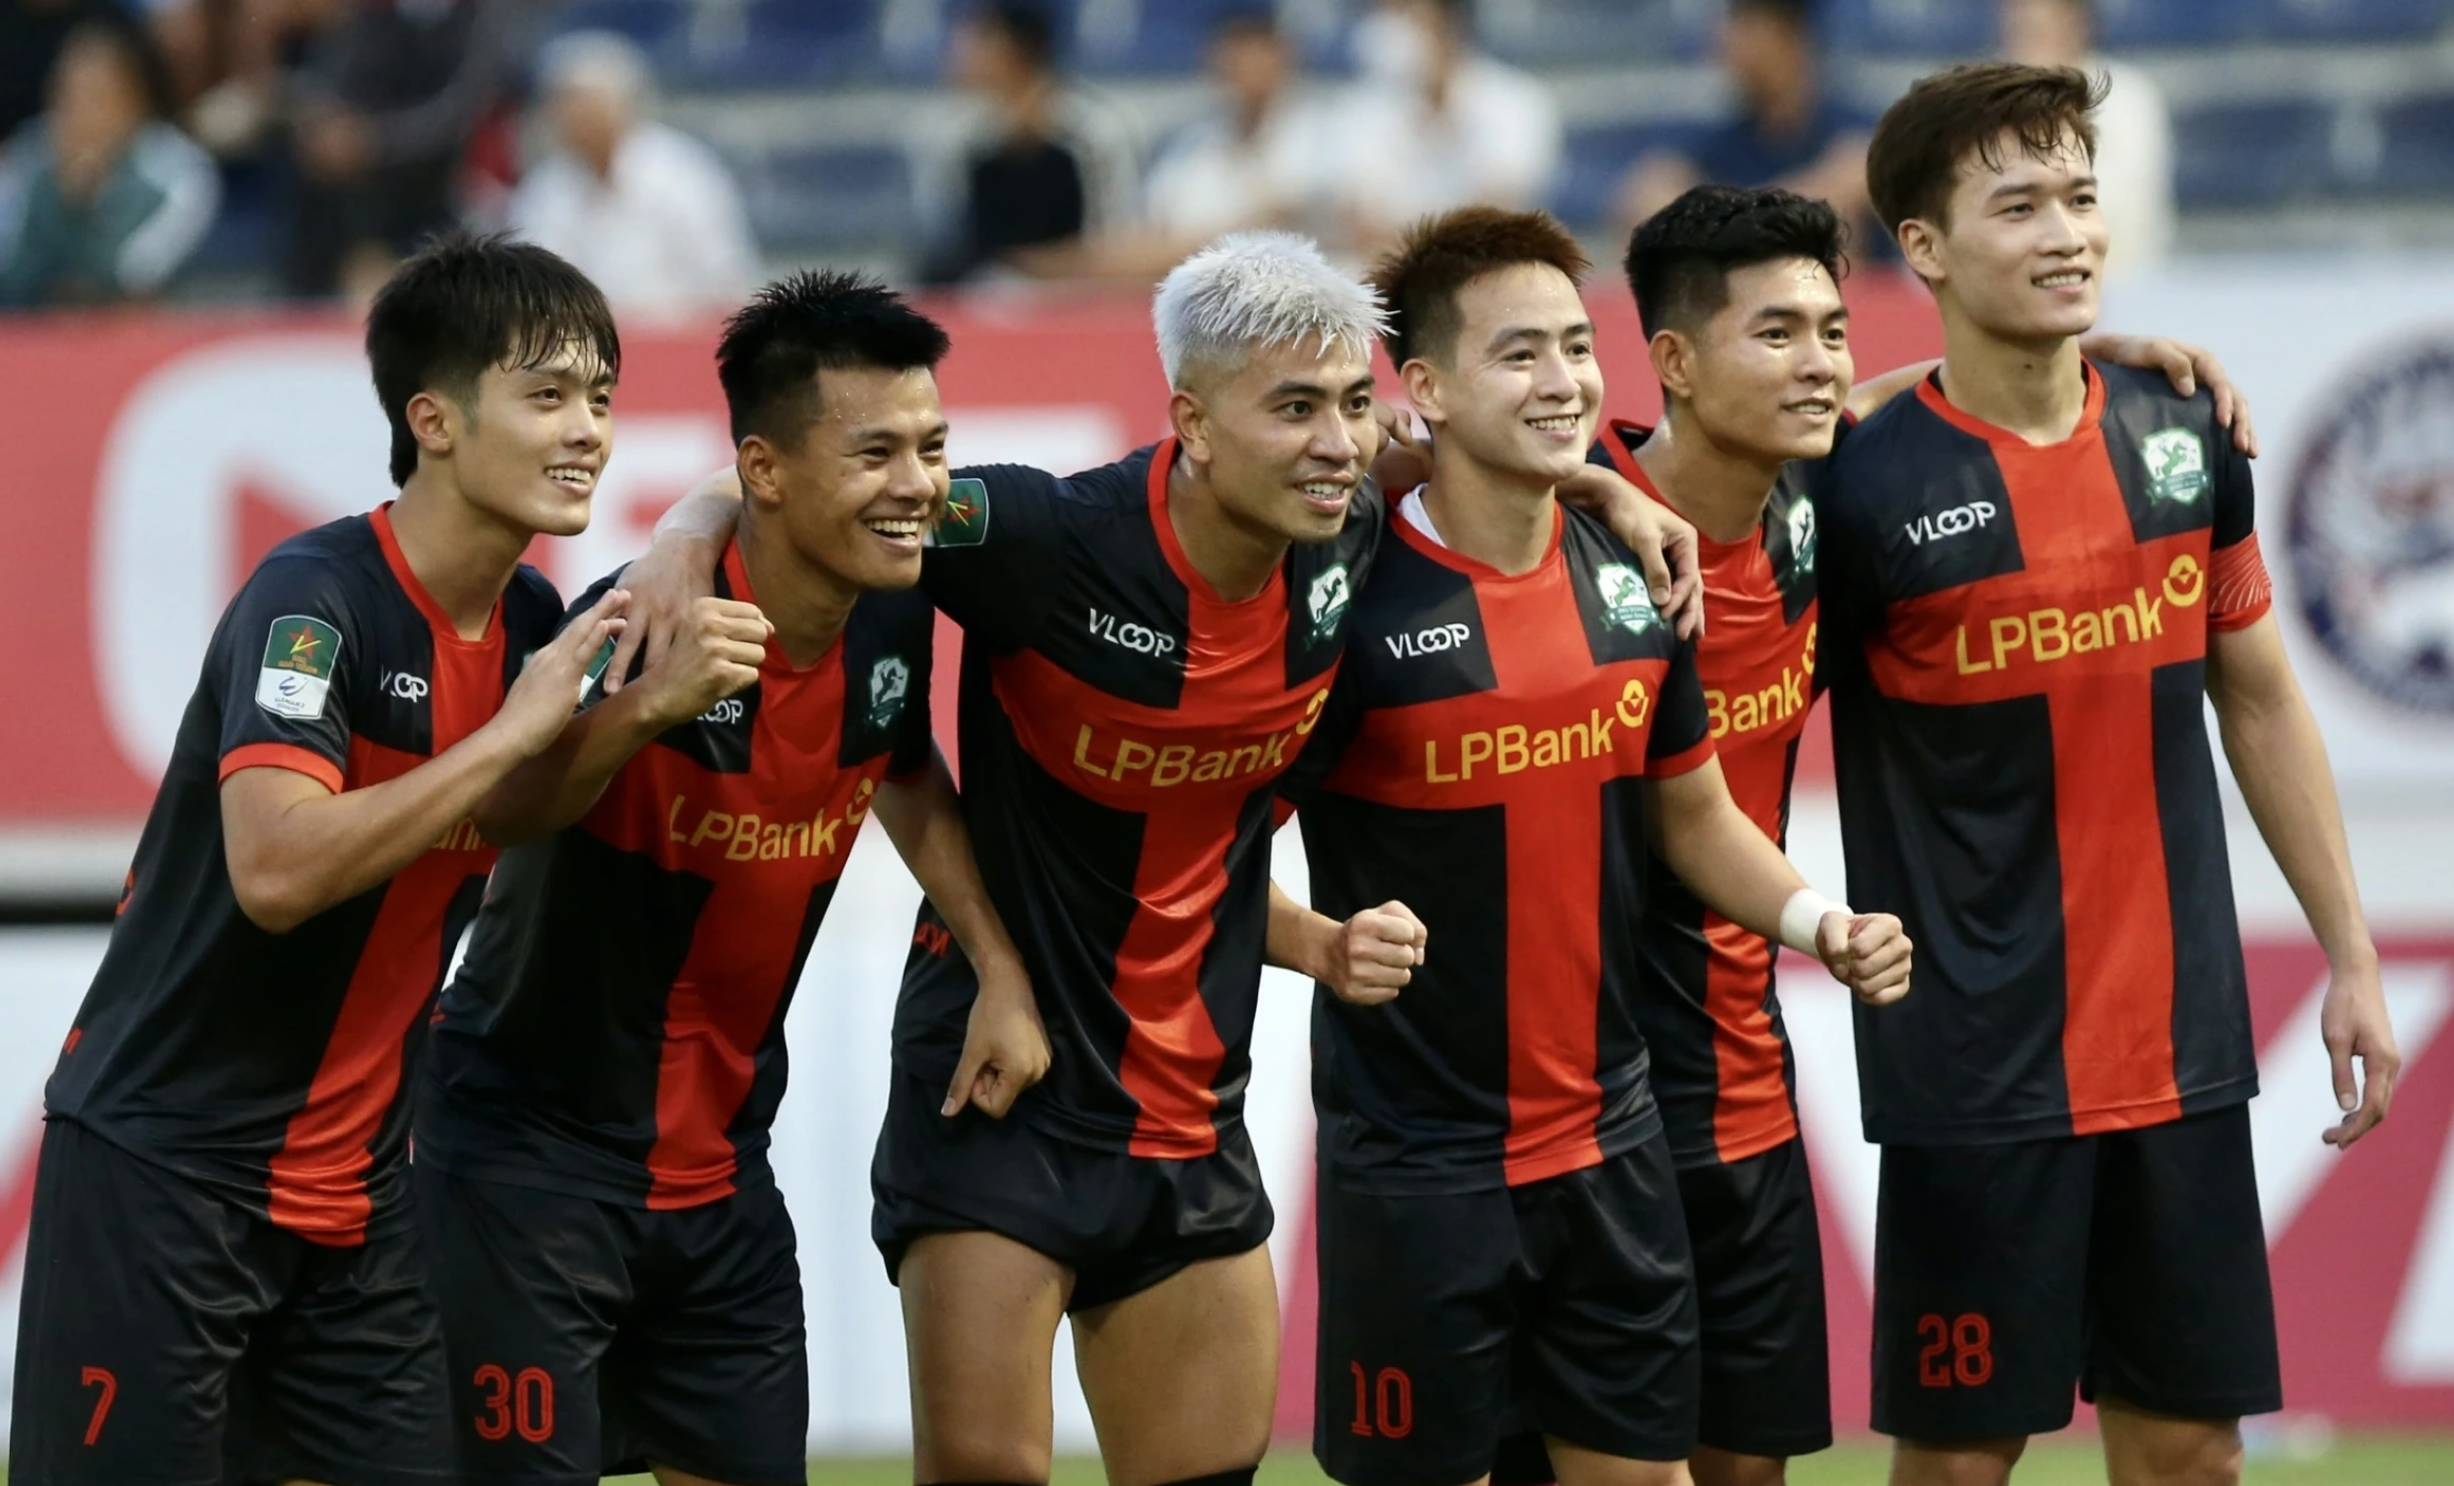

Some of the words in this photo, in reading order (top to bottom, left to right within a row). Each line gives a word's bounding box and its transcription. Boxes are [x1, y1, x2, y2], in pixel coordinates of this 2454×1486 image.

[1905, 500, 1996, 545] VLOOP
[1090, 607, 1176, 658] VLOOP
[1384, 622, 1470, 660] VLOOP
[1956, 587, 2163, 676] LPBank
[1703, 666, 1804, 739] Bank
[1073, 723, 1292, 787] LPBank
[1426, 708, 1616, 784] LPBank
[669, 794, 842, 862] LPBank
[1917, 1312, 1993, 1387] 28
[81, 1364, 118, 1446] 7
[473, 1363, 554, 1442] 30
[1350, 1359, 1412, 1438] 10
